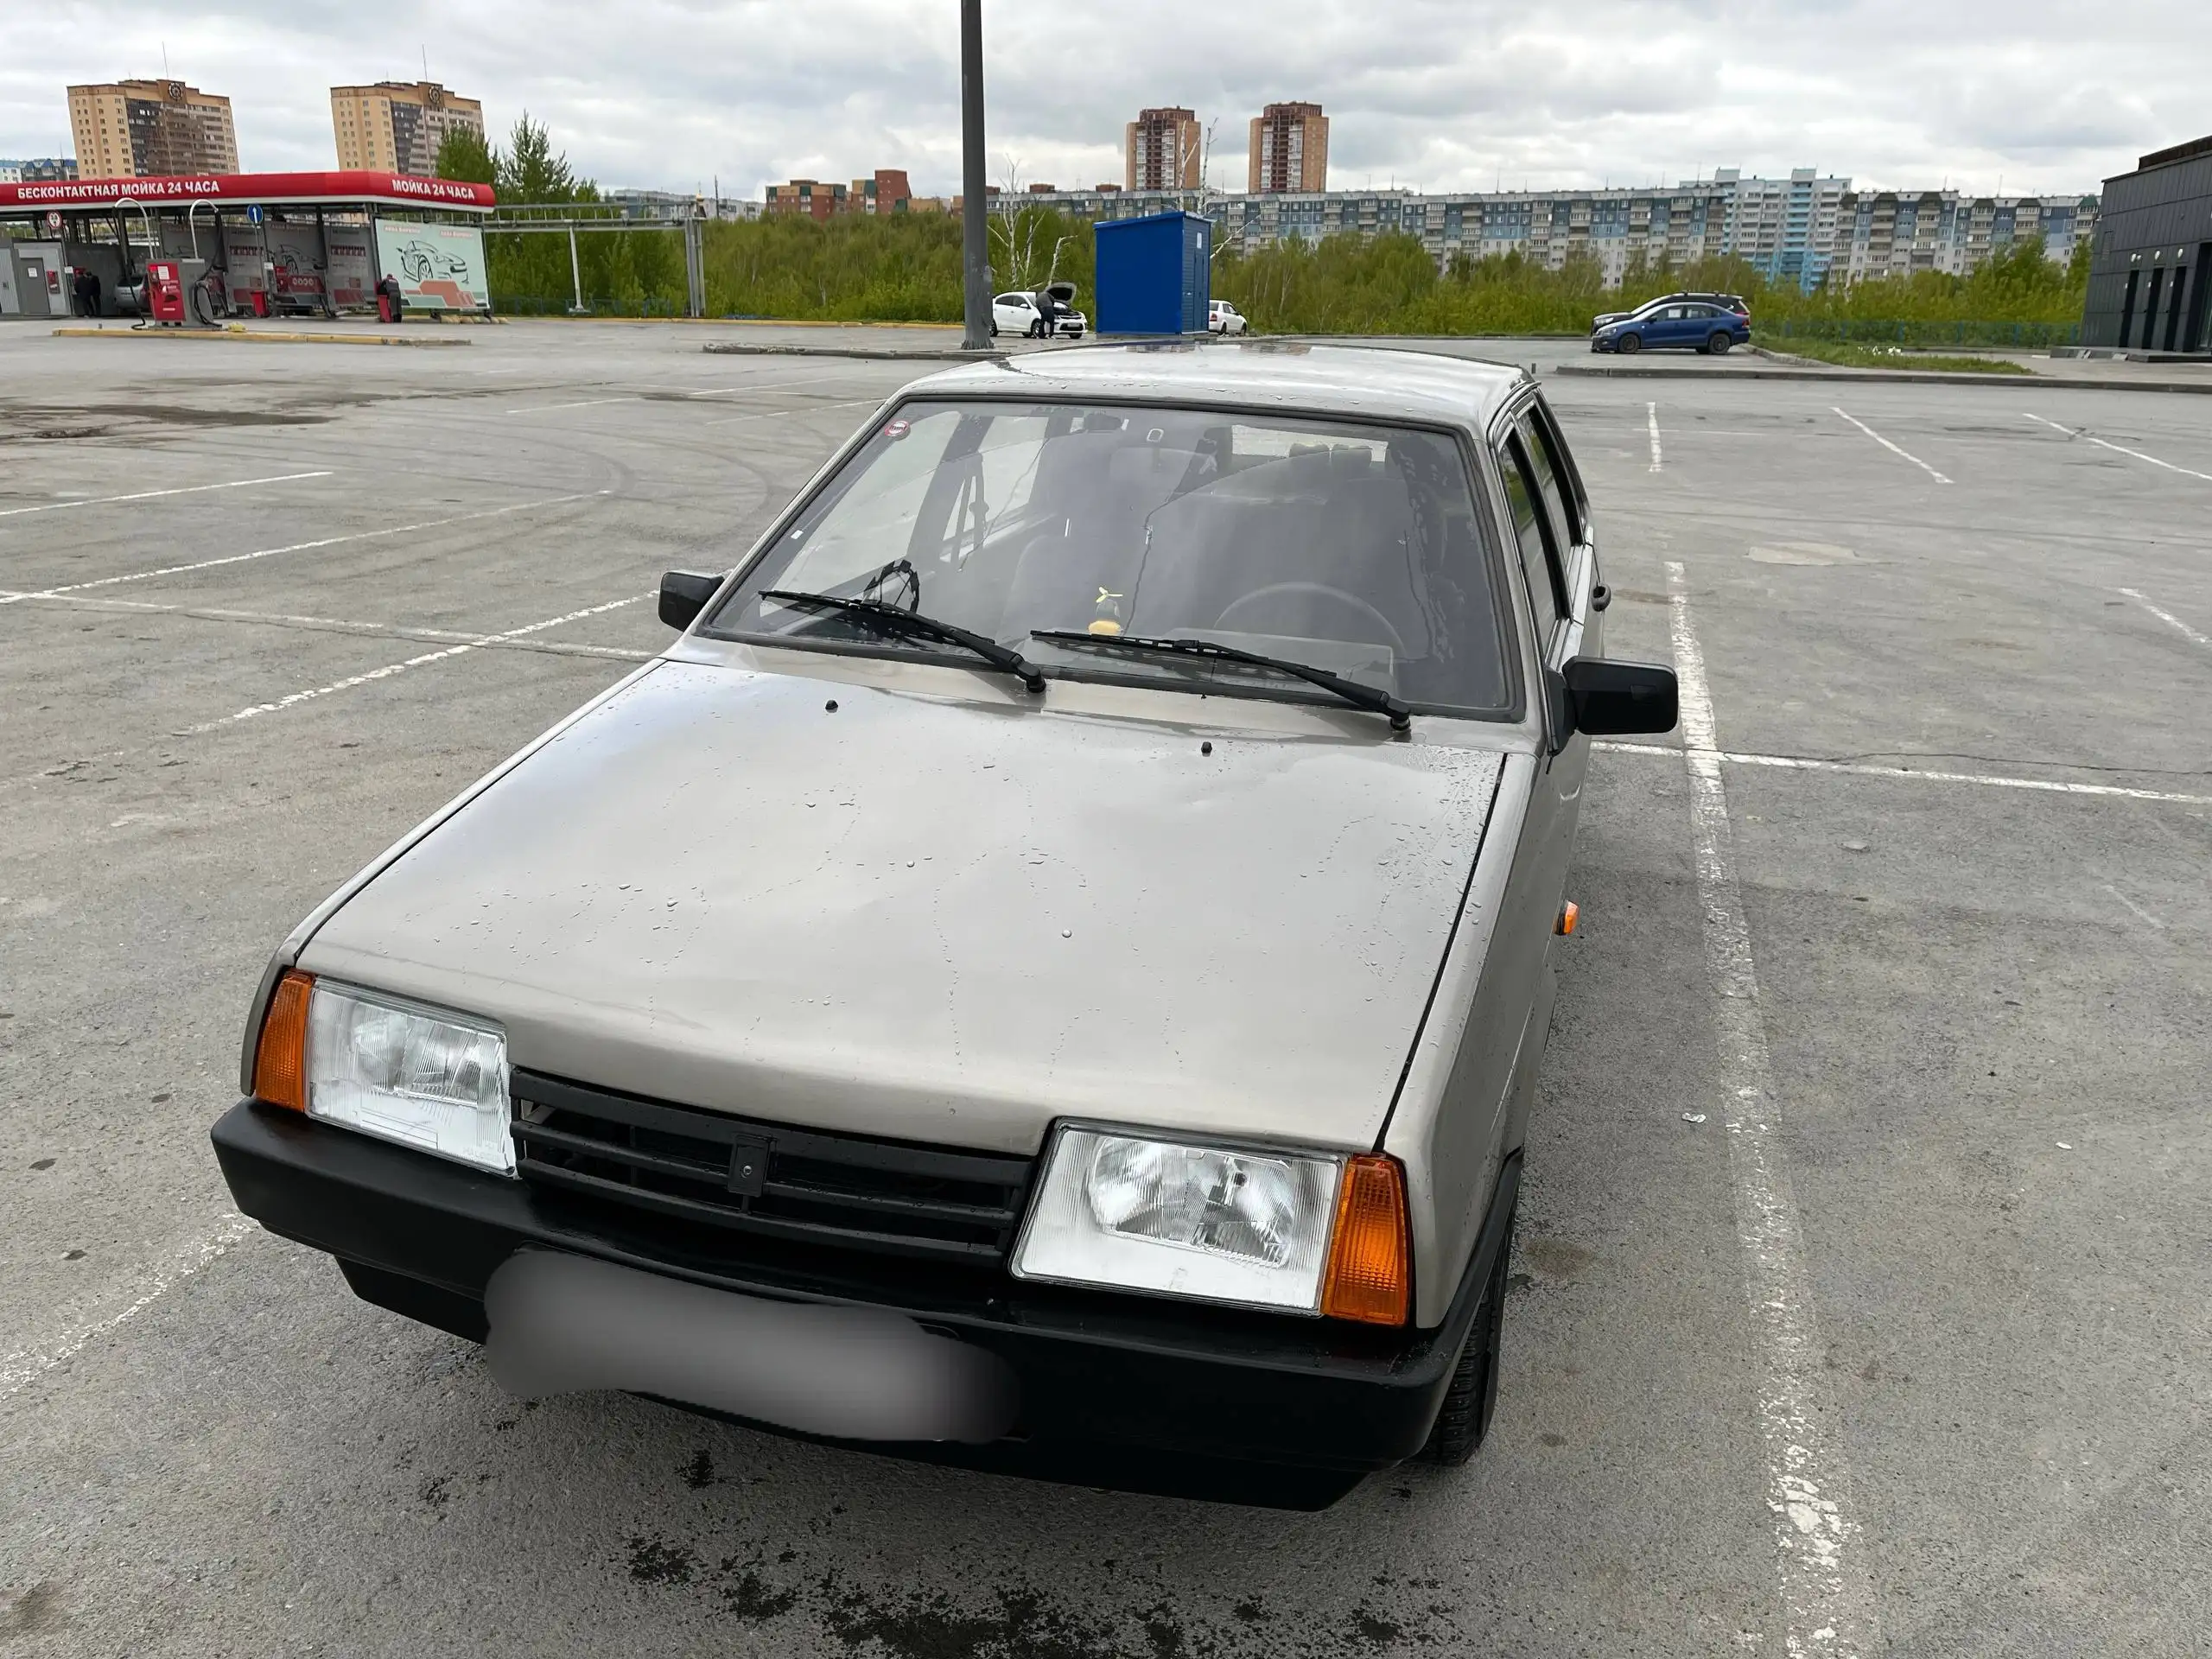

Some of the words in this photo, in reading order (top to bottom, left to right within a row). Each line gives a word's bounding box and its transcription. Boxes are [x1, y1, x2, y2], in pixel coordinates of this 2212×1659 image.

[17, 184, 119, 199] БЕСКОНТАКТНАЯ
[121, 181, 165, 195] МОЙКА
[168, 181, 182, 194] 24
[185, 181, 220, 193] ЧАСА
[391, 179, 431, 194] МОЙКА
[433, 184, 445, 197] 24
[447, 186, 474, 200] ЧАСА
